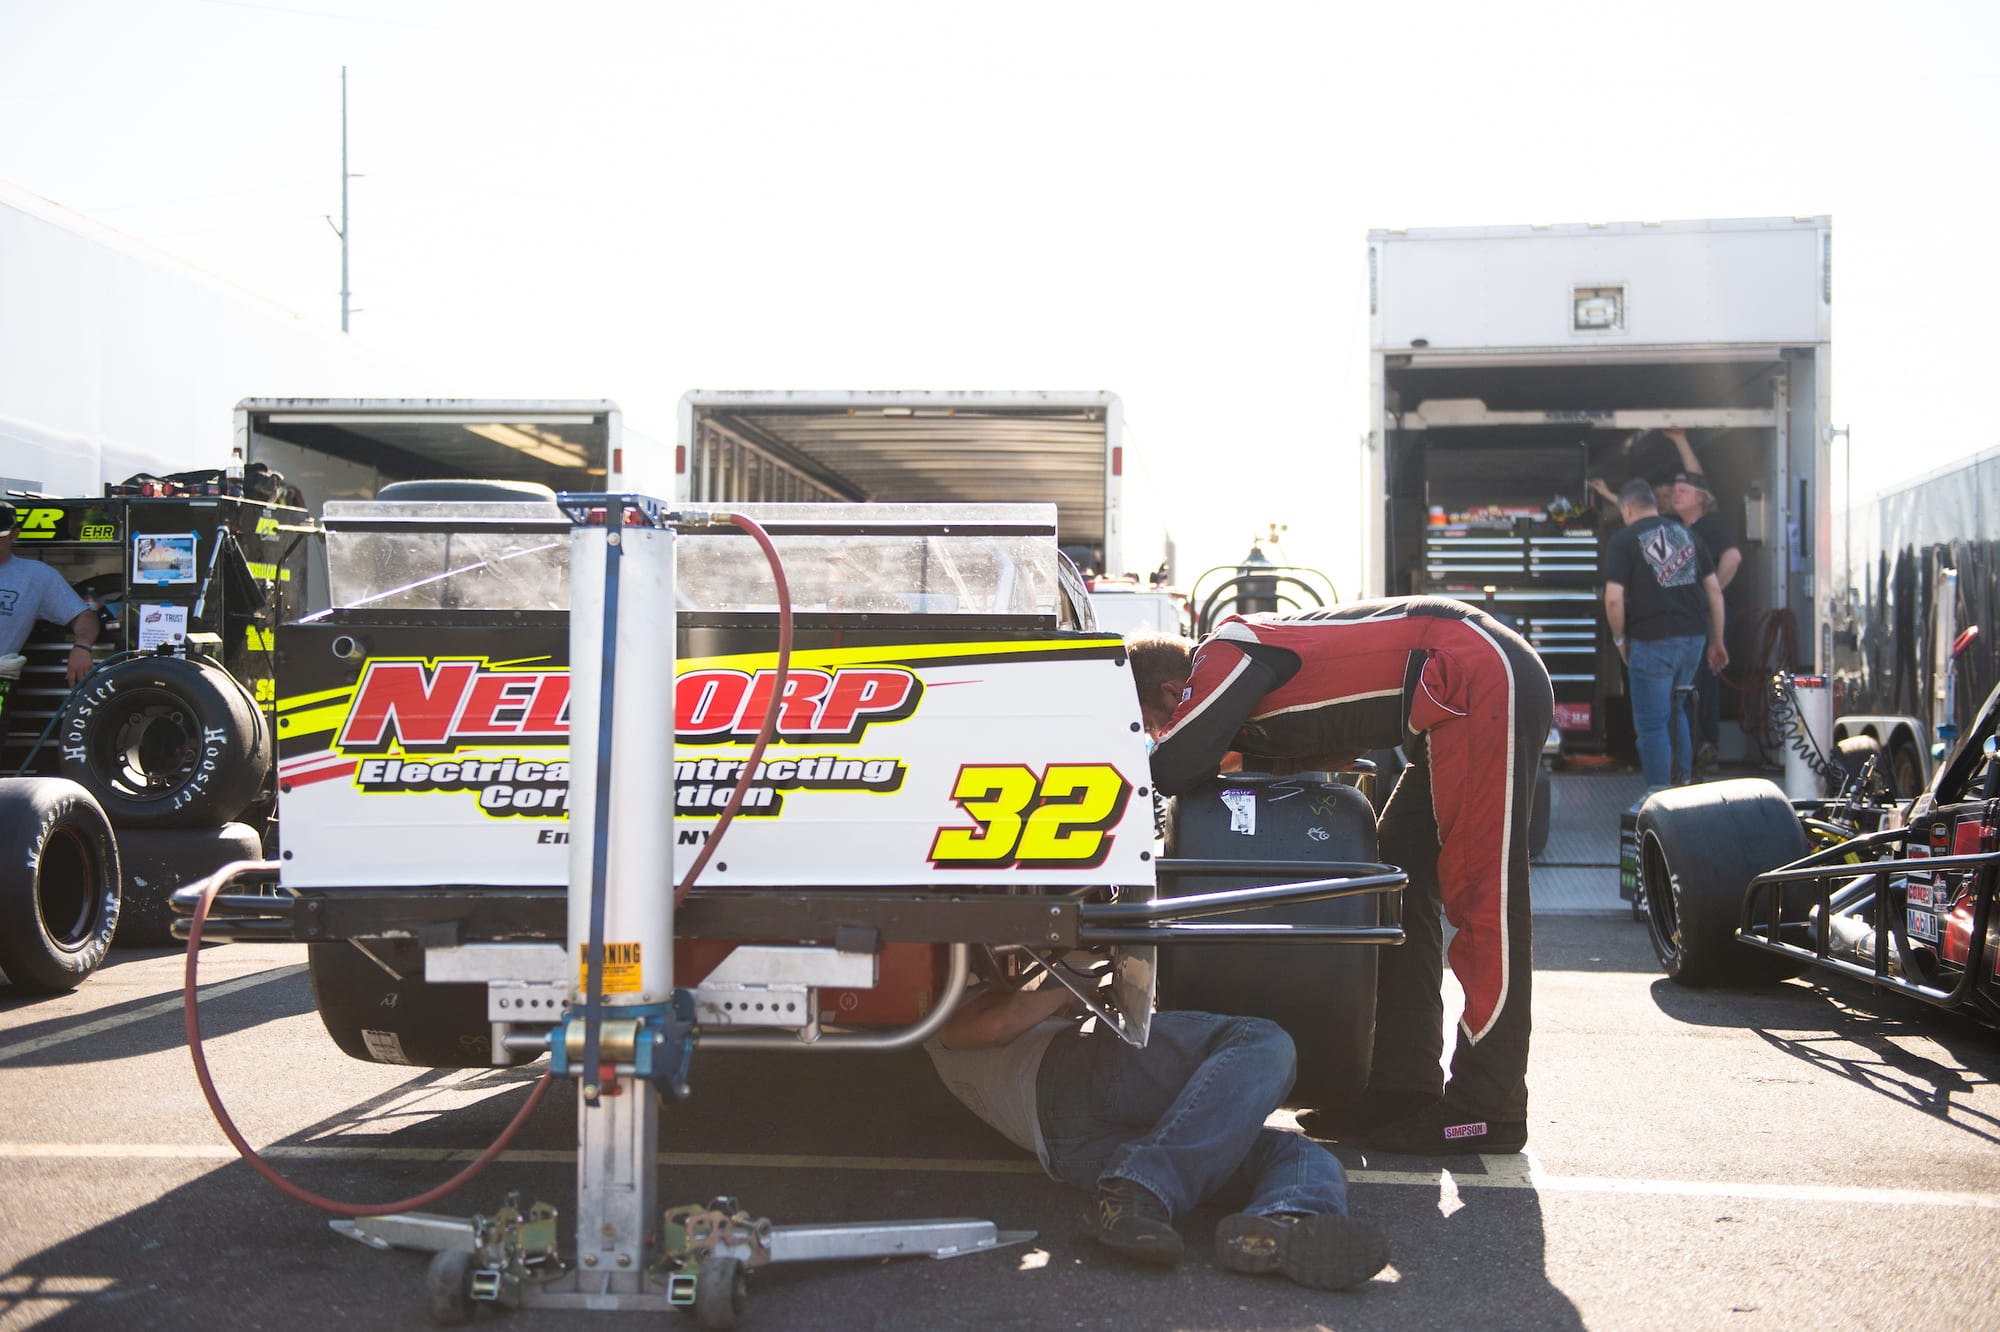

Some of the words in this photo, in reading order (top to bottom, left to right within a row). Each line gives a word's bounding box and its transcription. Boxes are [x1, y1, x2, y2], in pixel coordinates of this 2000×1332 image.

[82, 526, 114, 537] EHR
[165, 613, 183, 623] TRUST
[63, 679, 118, 763] Hoosier
[338, 661, 914, 747] NELORP
[173, 725, 229, 810] Hoosier
[27, 796, 76, 868] Hoosier
[927, 763, 1133, 868] 32
[77, 891, 122, 973] Hoosier
[581, 943, 641, 964] WNING
[1908, 910, 1929, 933] Mobil
[1446, 1124, 1483, 1138] SIMPSON
